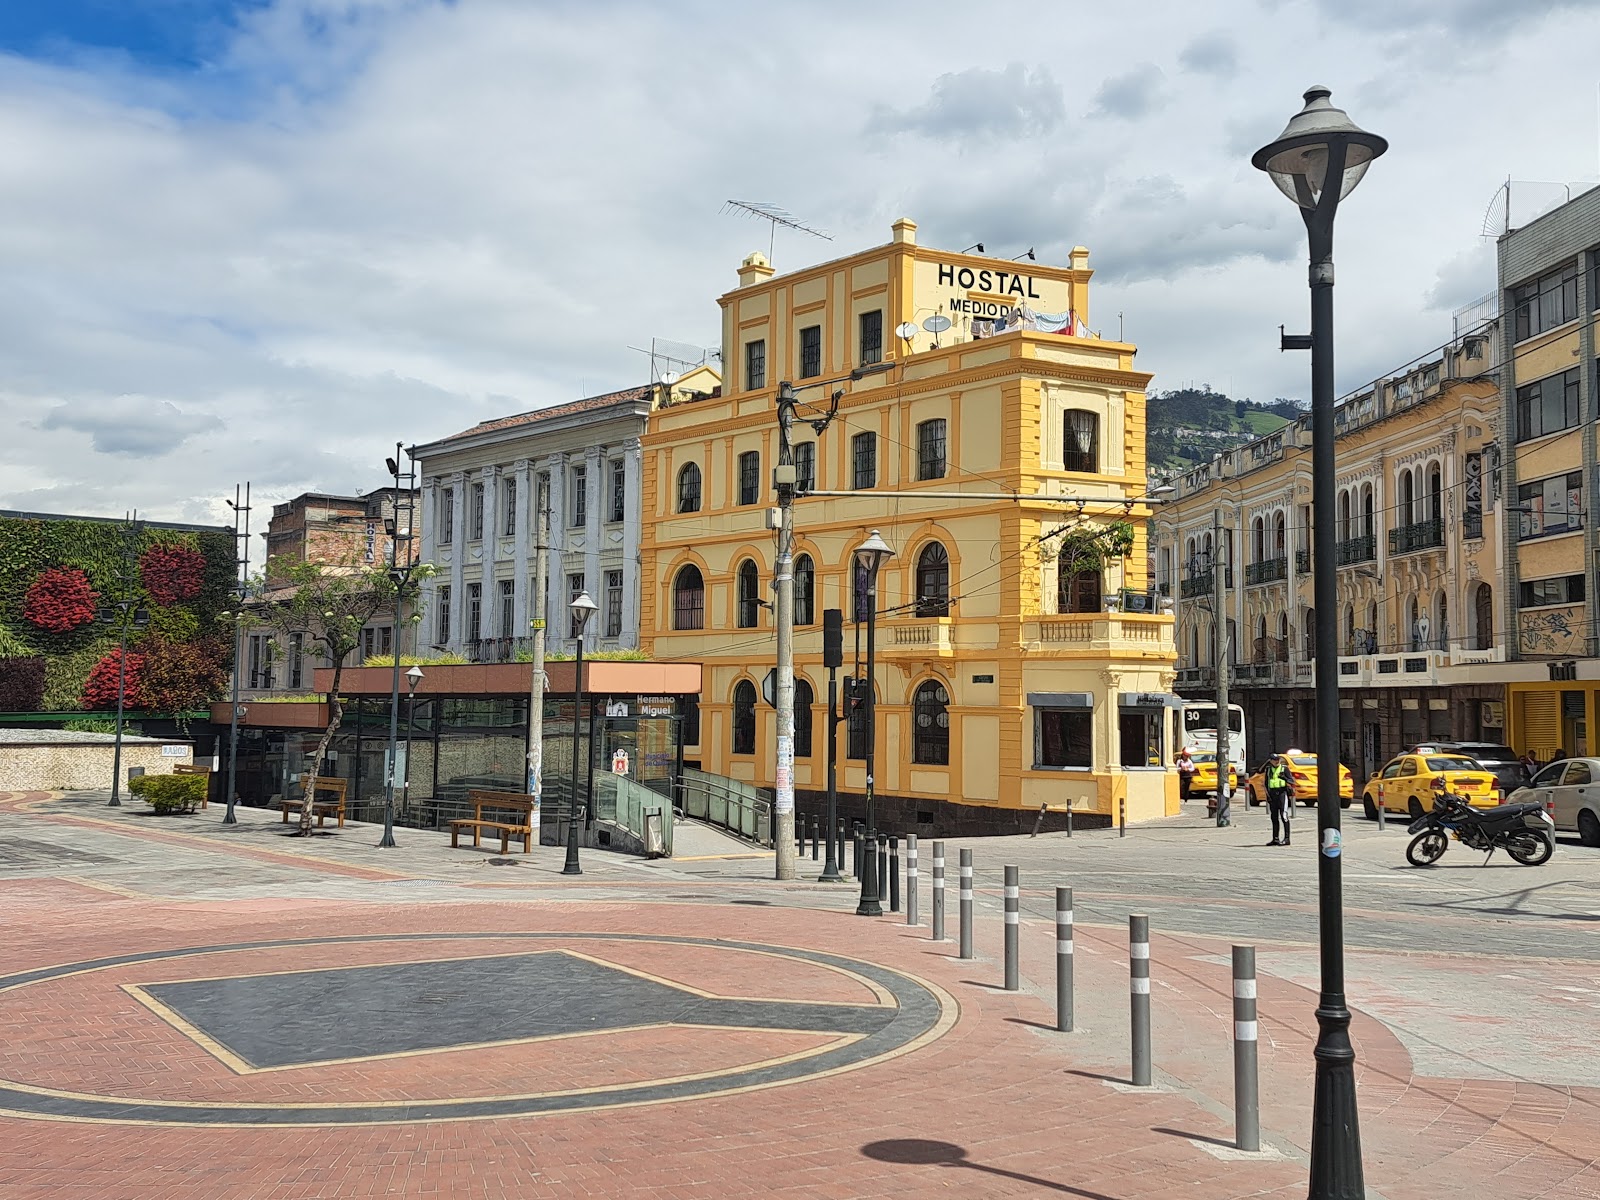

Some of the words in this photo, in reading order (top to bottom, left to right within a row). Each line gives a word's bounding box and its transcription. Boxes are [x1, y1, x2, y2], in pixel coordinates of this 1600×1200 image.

[938, 263, 1040, 299] HOSTAL
[366, 523, 375, 561] HOSTAL
[636, 694, 676, 704] Hermano
[641, 704, 671, 717] Miguel
[1186, 710, 1200, 721] 30
